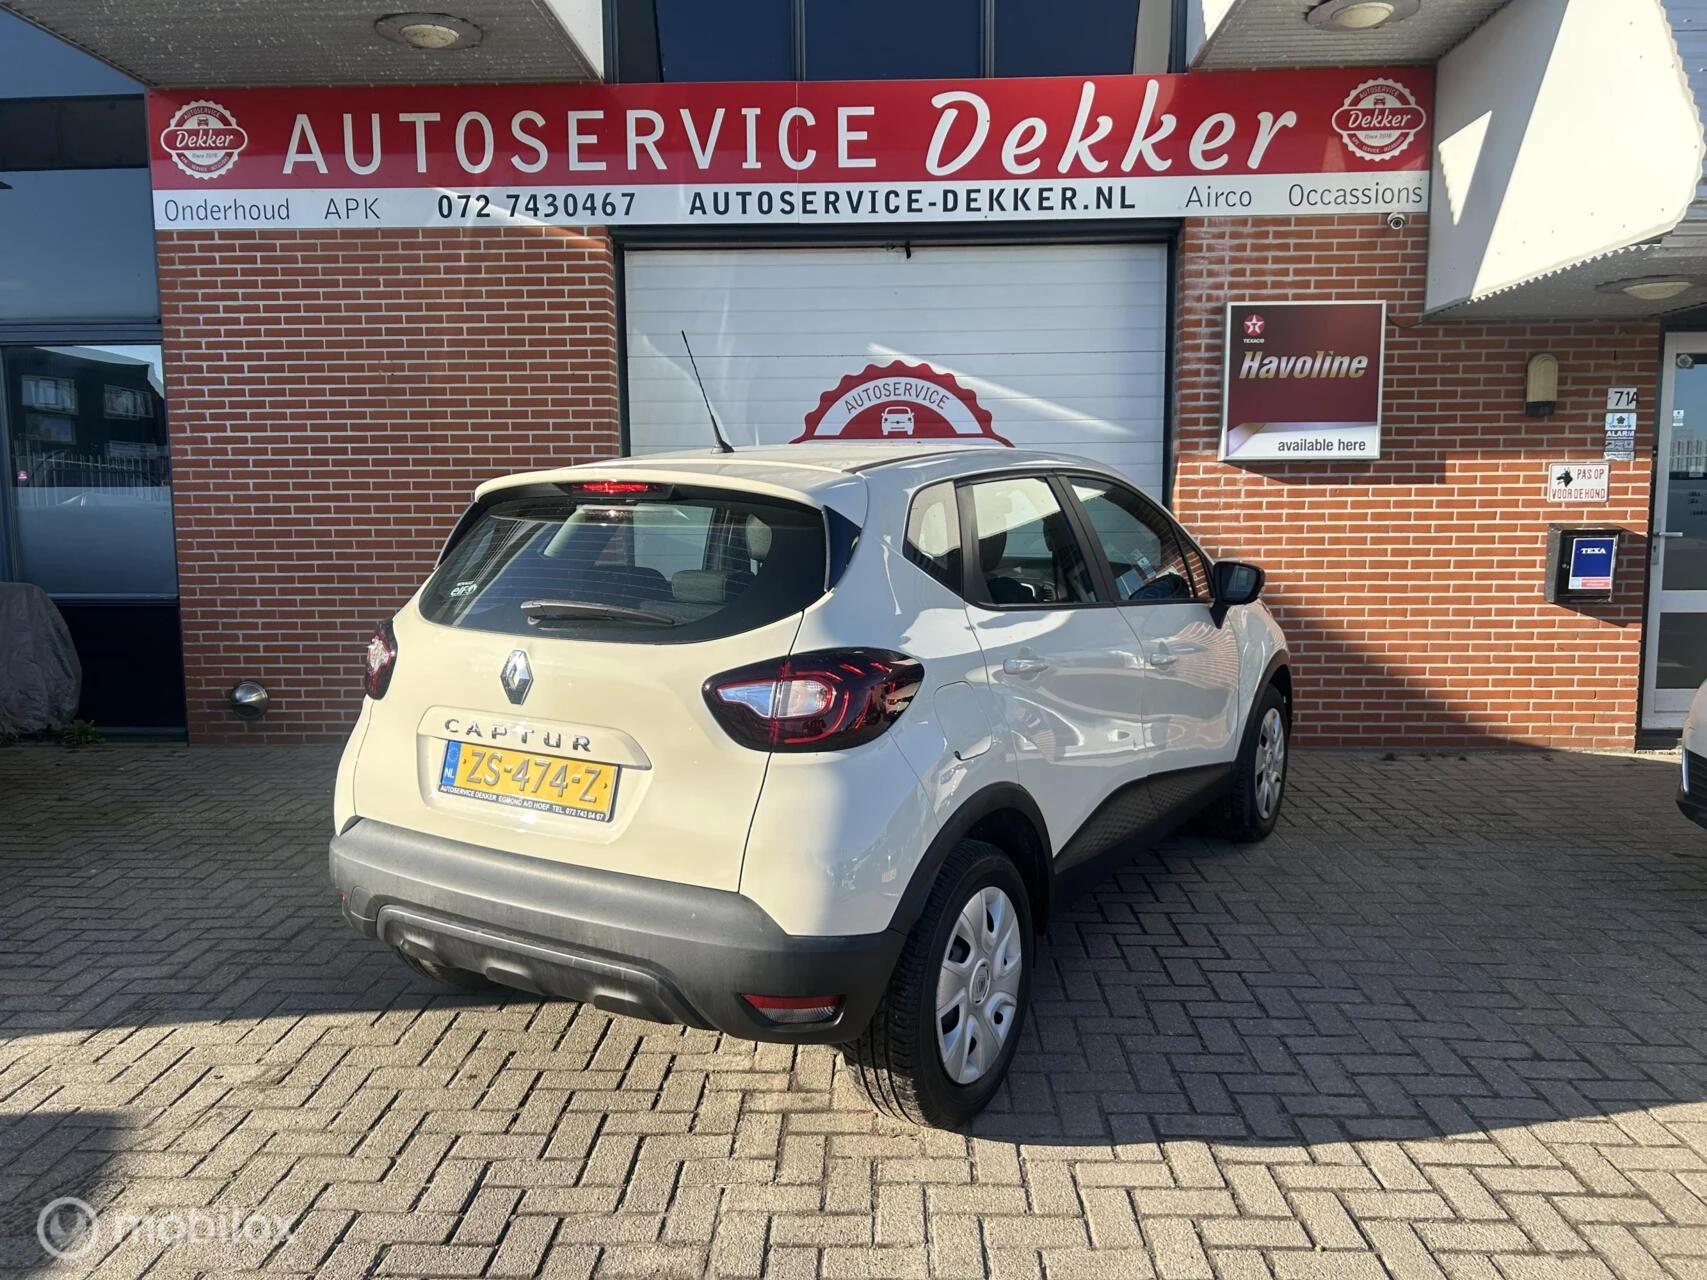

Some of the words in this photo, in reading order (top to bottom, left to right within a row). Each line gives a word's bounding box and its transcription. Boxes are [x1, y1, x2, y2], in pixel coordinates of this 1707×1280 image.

[1359, 86, 1400, 98] AUTOSERVICE
[183, 107, 220, 119] AUTOSERVICE
[1348, 108, 1411, 128] Dekker
[282, 105, 877, 176] AUTOSERVICE
[925, 79, 1297, 176] Dekker
[176, 129, 233, 147] Dekker
[164, 197, 290, 222] Onderhoud
[324, 197, 381, 221] APK
[437, 193, 491, 218] 072
[506, 191, 636, 218] 7430467
[689, 186, 1136, 216] AUTOSERVICE-DEKKER.NL
[1185, 185, 1252, 208] Airco
[1288, 182, 1422, 207] Occassions
[1239, 351, 1368, 379] Havoline
[844, 382, 950, 414] AUTOSERVICE
[1614, 391, 1640, 406] 71A
[1278, 439, 1334, 451] available
[1338, 439, 1366, 451] here
[1577, 469, 1592, 479] PAS
[1594, 469, 1604, 479] OP
[1552, 489, 1572, 499] VOOR
[1574, 489, 1584, 499] DE
[1585, 488, 1605, 499] HOND
[444, 718, 592, 752] CAPTUR
[444, 767, 455, 778] NL
[466, 750, 601, 804] ZS-474-Z
[440, 785, 474, 797] AUTOSERVICE
[475, 791, 496, 801] DEKKER
[498, 795, 522, 805] EGMOND
[533, 802, 550, 810] HOEF
[565, 808, 576, 816] 072
